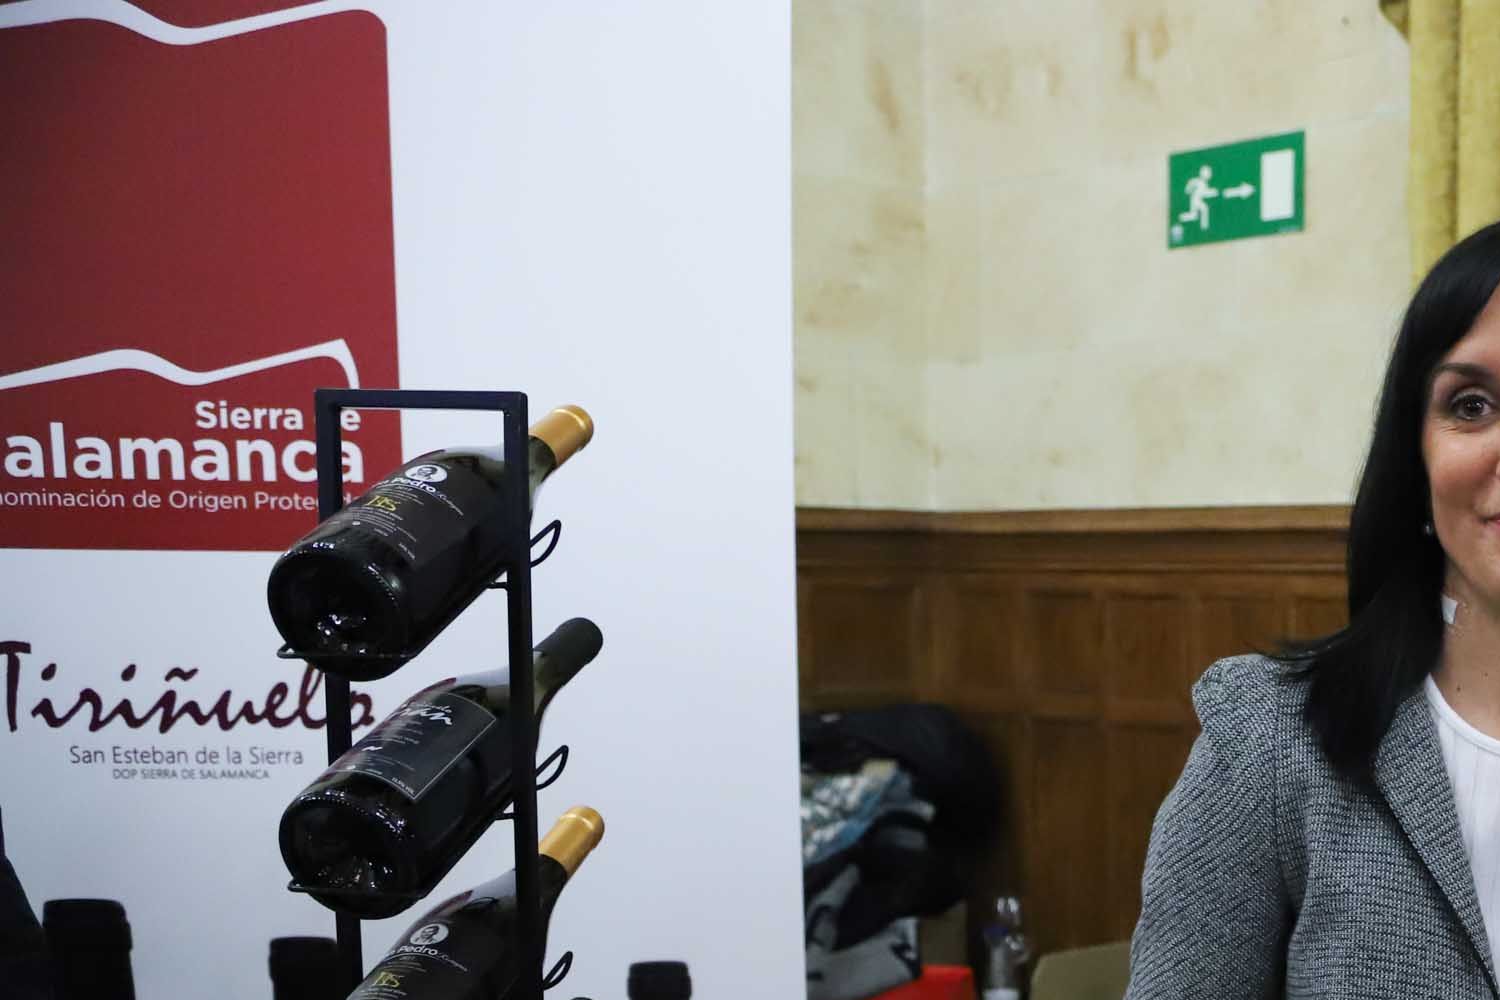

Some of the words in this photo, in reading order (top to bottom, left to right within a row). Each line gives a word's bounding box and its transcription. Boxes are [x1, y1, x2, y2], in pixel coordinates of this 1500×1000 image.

[195, 400, 304, 431] Sierra
[4, 421, 364, 483] alamanca
[0, 487, 125, 508] ominación
[133, 490, 162, 508] de
[169, 490, 248, 512] Origen
[69, 746, 105, 766] San
[112, 746, 189, 766] Esteban
[195, 746, 221, 766] de
[226, 746, 243, 766] la
[250, 747, 304, 767] Sierra
